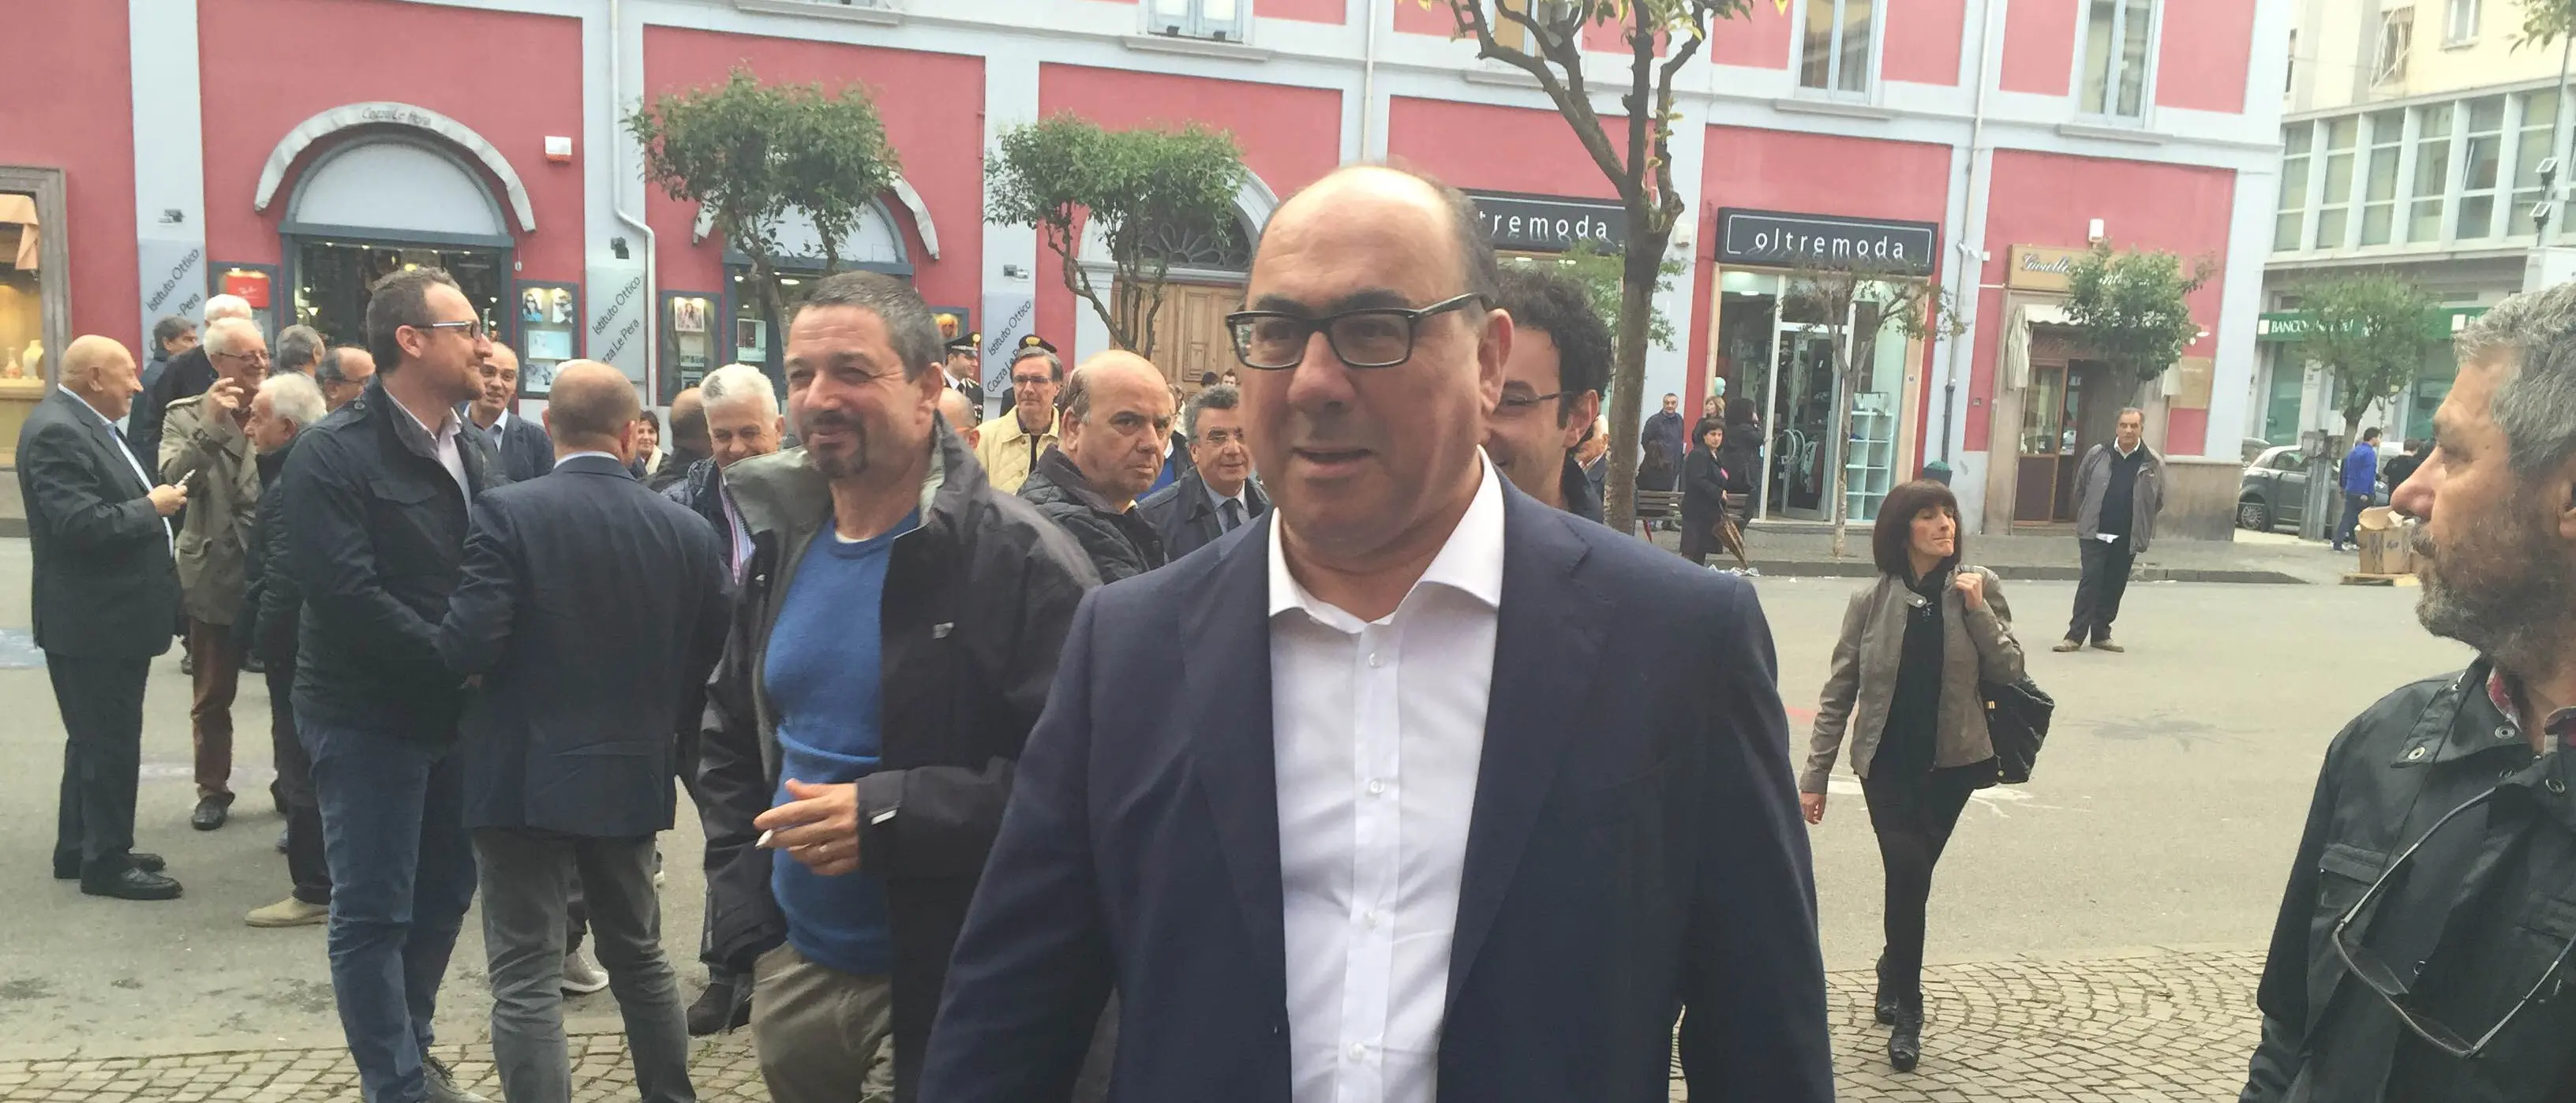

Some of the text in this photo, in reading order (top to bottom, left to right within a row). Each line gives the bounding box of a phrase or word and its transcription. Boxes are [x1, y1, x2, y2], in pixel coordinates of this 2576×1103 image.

[1754, 227, 1904, 260] oltremoda
[146, 249, 200, 313] Istituto Ottico
[178, 293, 201, 316] Pera
[592, 276, 641, 336] Istituto Ottico
[612, 337, 625, 352] Le
[620, 318, 640, 341] Pera
[987, 301, 1032, 357] Istituto Ottico
[987, 368, 1009, 393] Cozza
